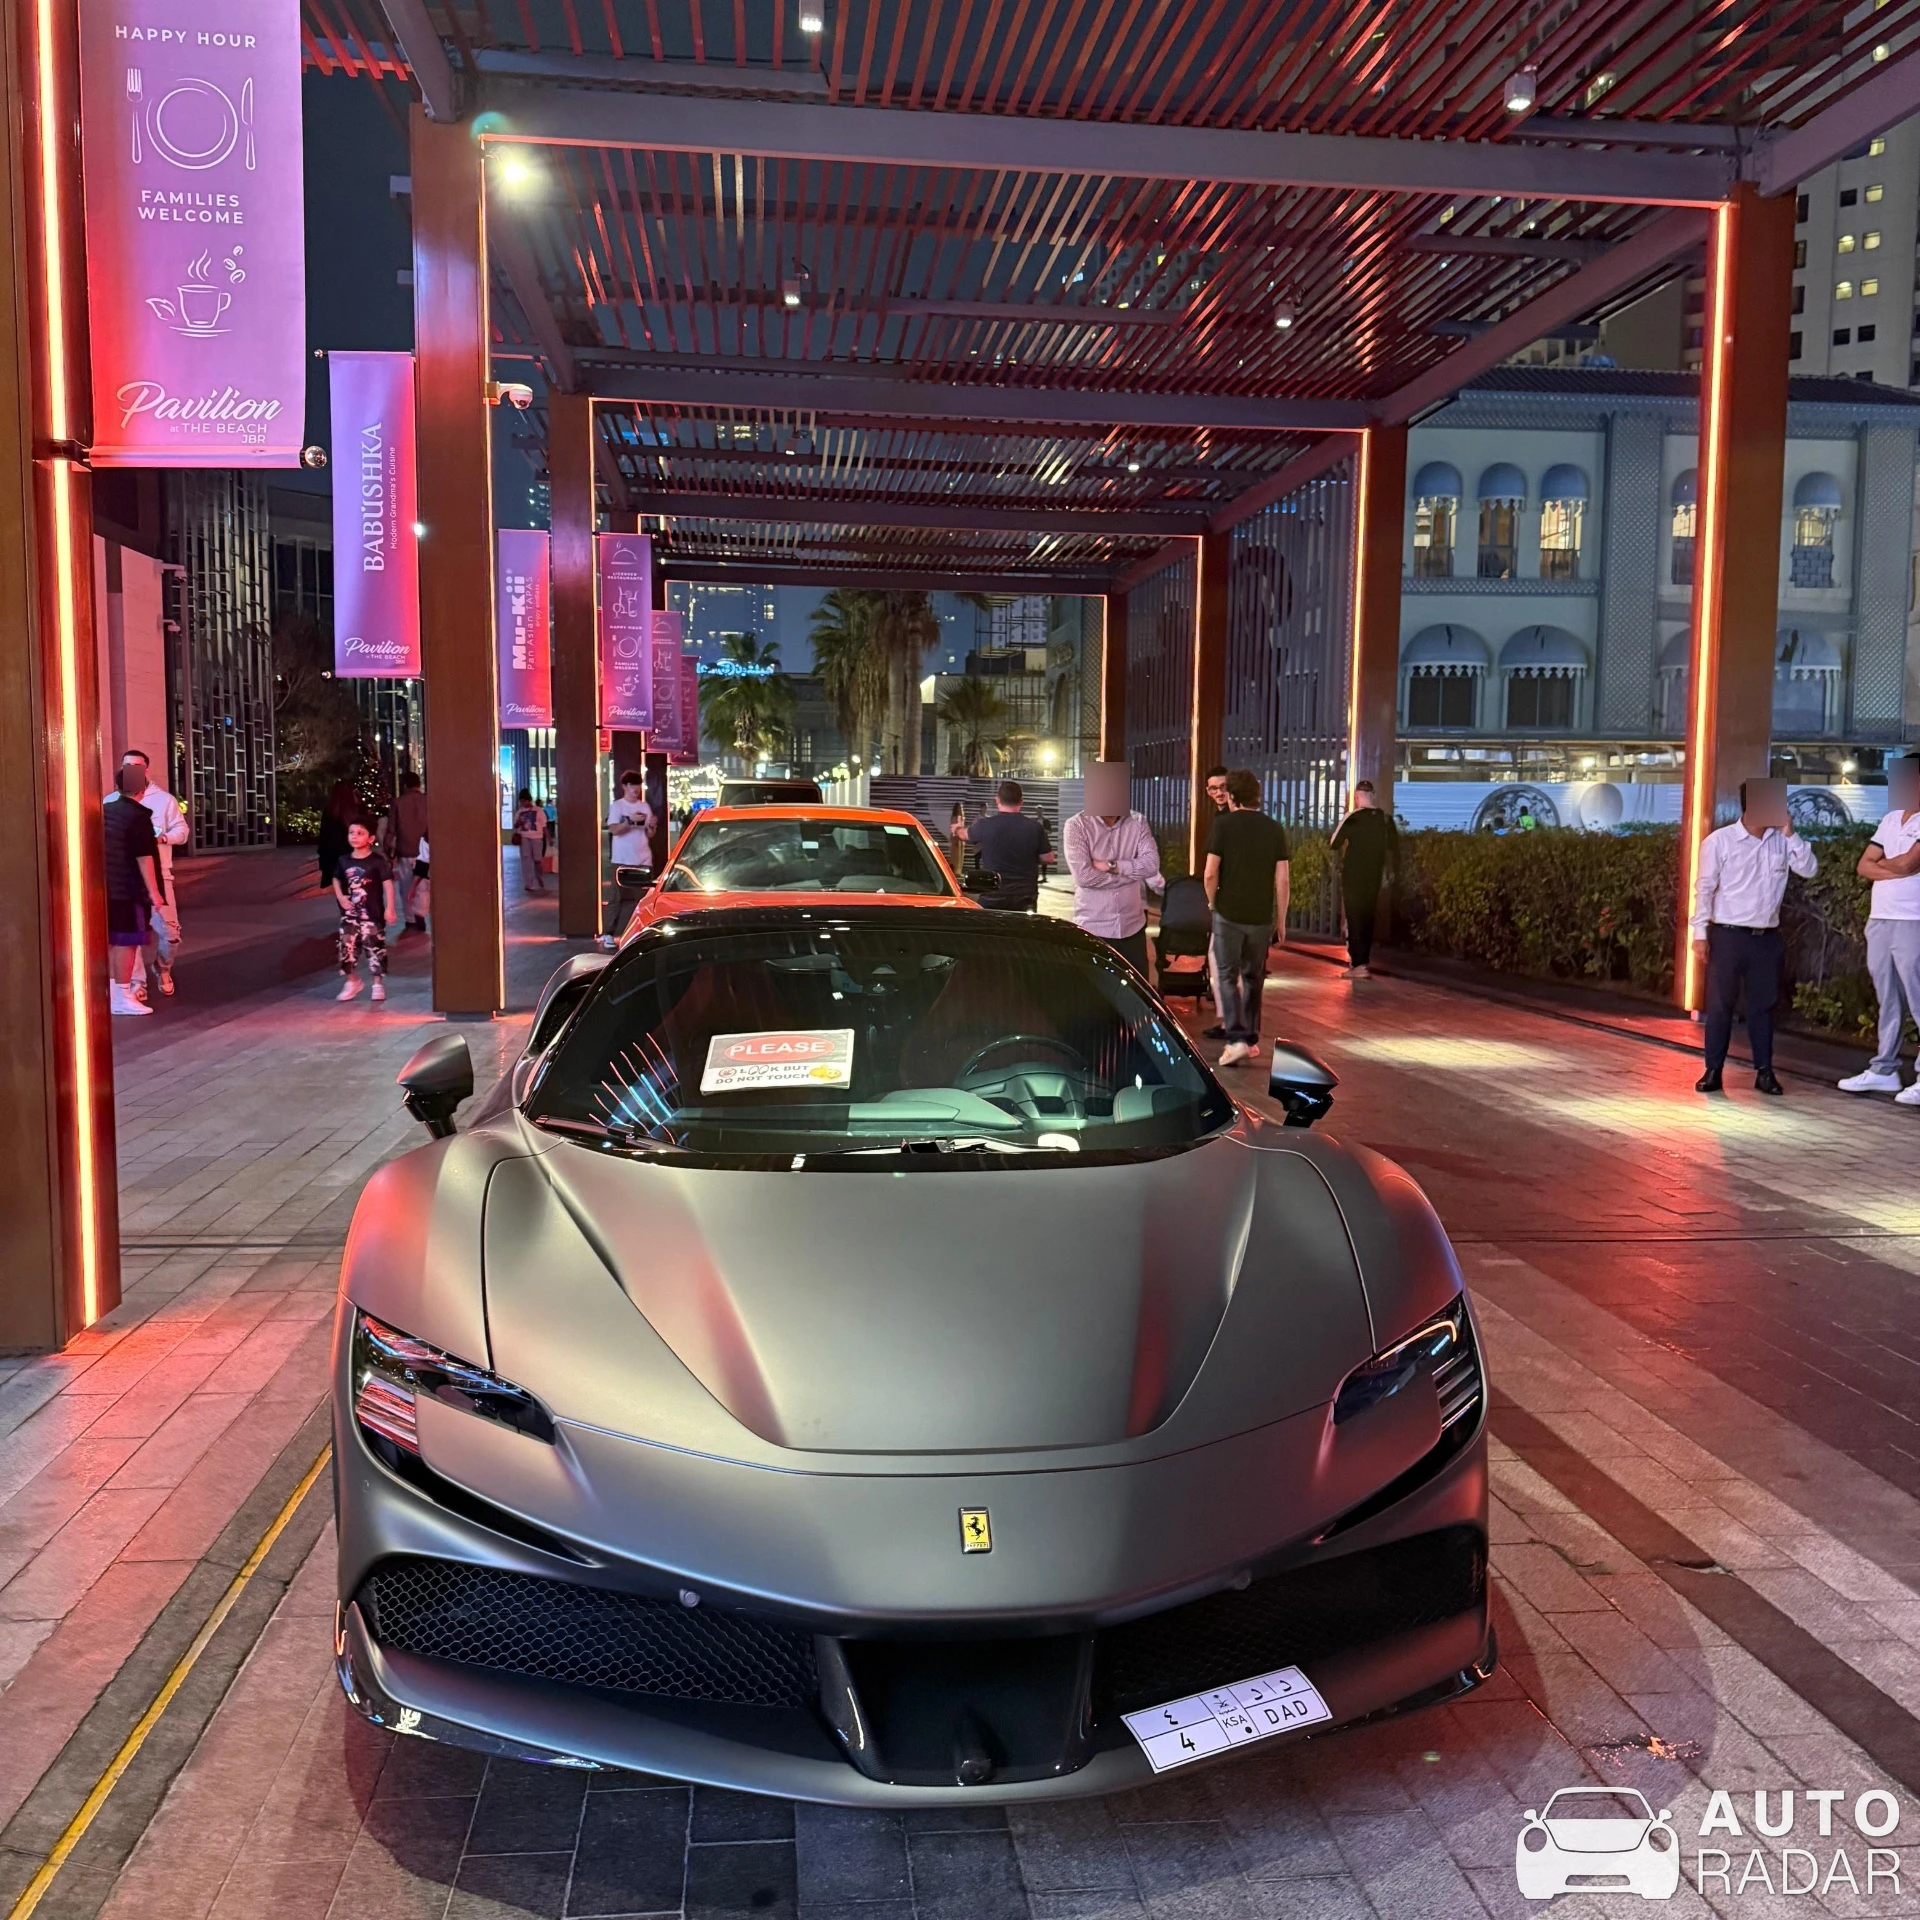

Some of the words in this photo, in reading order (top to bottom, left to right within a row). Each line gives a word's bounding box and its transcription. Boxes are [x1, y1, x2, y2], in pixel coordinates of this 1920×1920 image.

[115, 25, 187, 44] HAPPY
[197, 32, 256, 48] HOUR
[141, 190, 240, 208] FAMILIES
[137, 206, 244, 225] WELCOME
[116, 380, 283, 430] Pavilion
[170, 424, 179, 433] at
[182, 422, 211, 434] THE
[216, 423, 267, 434] BEACH
[241, 434, 266, 444] JBR
[389, 477, 397, 517] Grandma's
[525, 576, 533, 610] TAPAS
[526, 615, 534, 646] Asian
[344, 637, 411, 657] Pavilion
[527, 650, 535, 670] Pan
[506, 703, 546, 715] Pavilion
[608, 705, 647, 718] Pavilion
[729, 1041, 826, 1057] PLEASE
[715, 1077, 733, 1085] DO
[767, 1073, 810, 1081] TOUCH
[1222, 1714, 1248, 1729] KSA
[1263, 1699, 1309, 1725] DAD
[1180, 1732, 1196, 1752] 4
